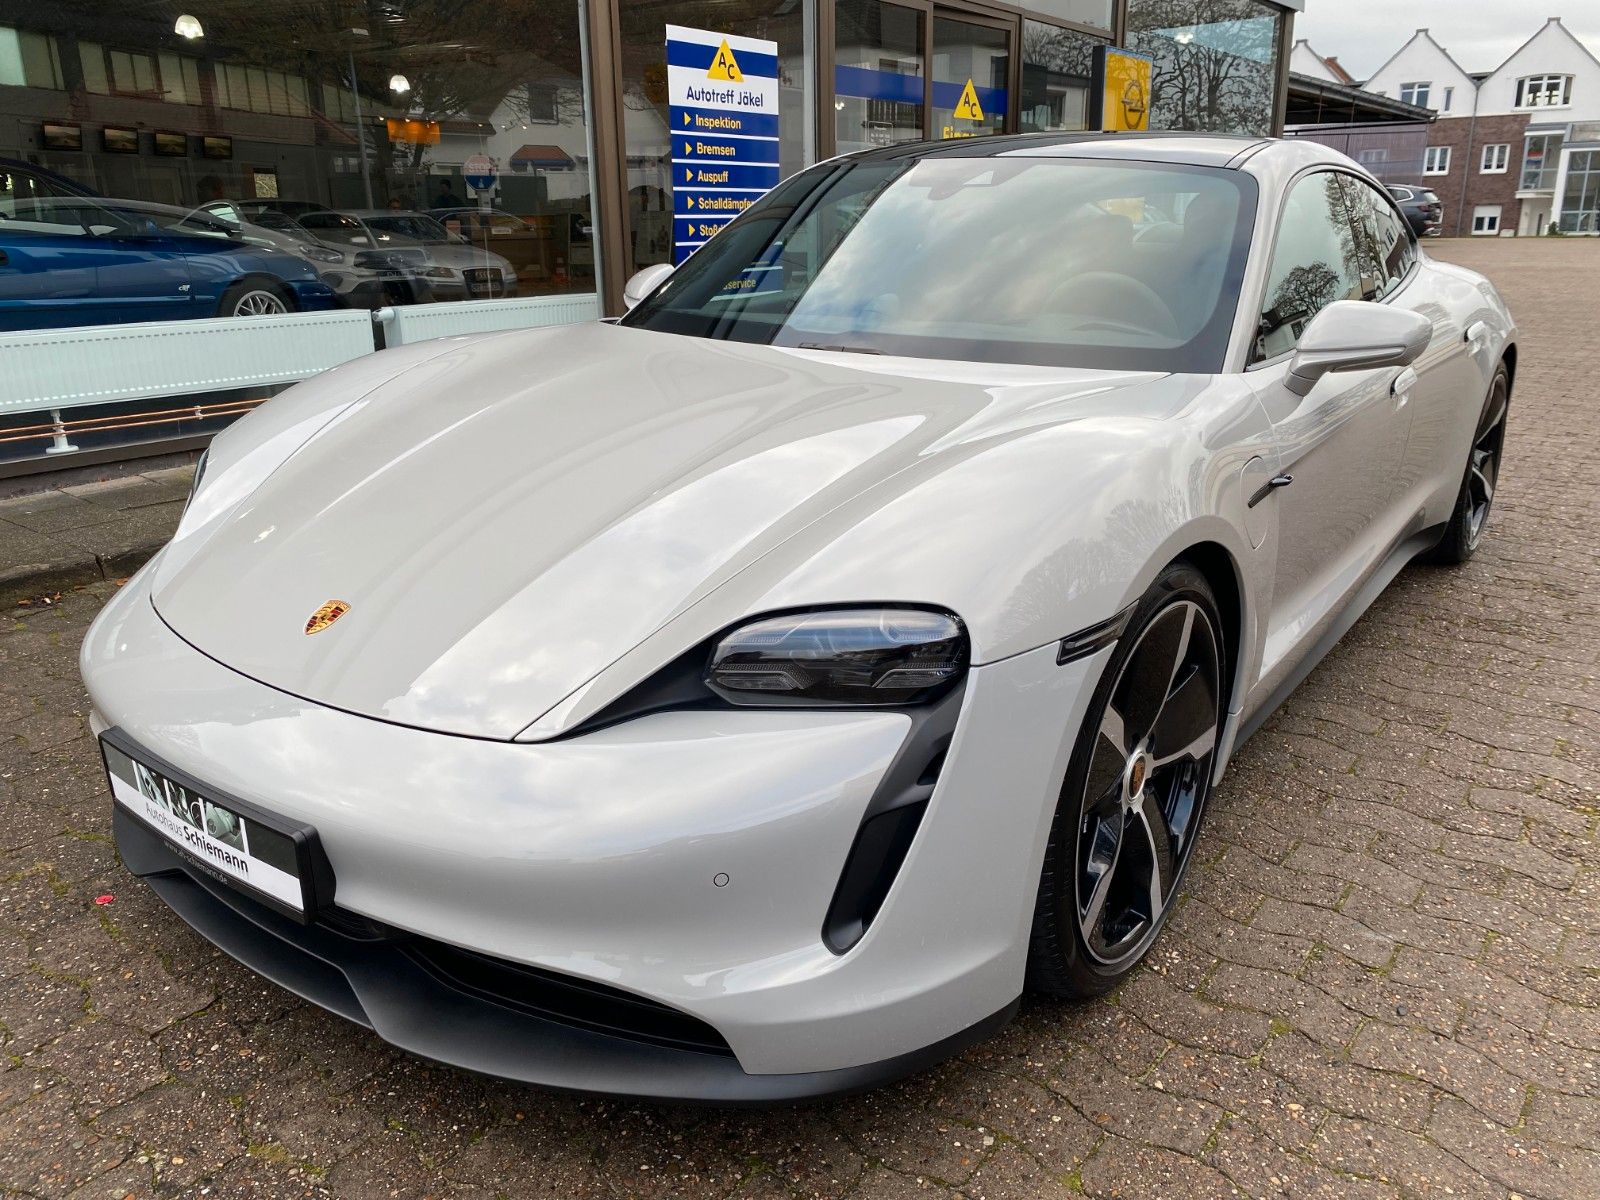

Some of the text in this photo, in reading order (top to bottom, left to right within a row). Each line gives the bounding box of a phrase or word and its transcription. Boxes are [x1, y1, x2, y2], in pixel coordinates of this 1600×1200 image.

[687, 86, 764, 107] Autotreff Jäkel
[695, 114, 741, 130] Inspektion
[696, 142, 736, 156] Bremsen
[697, 170, 729, 185] Auspuff
[699, 224, 726, 236] Stoß
[723, 279, 757, 290] service
[145, 803, 248, 872] Autohaus Schiemann
